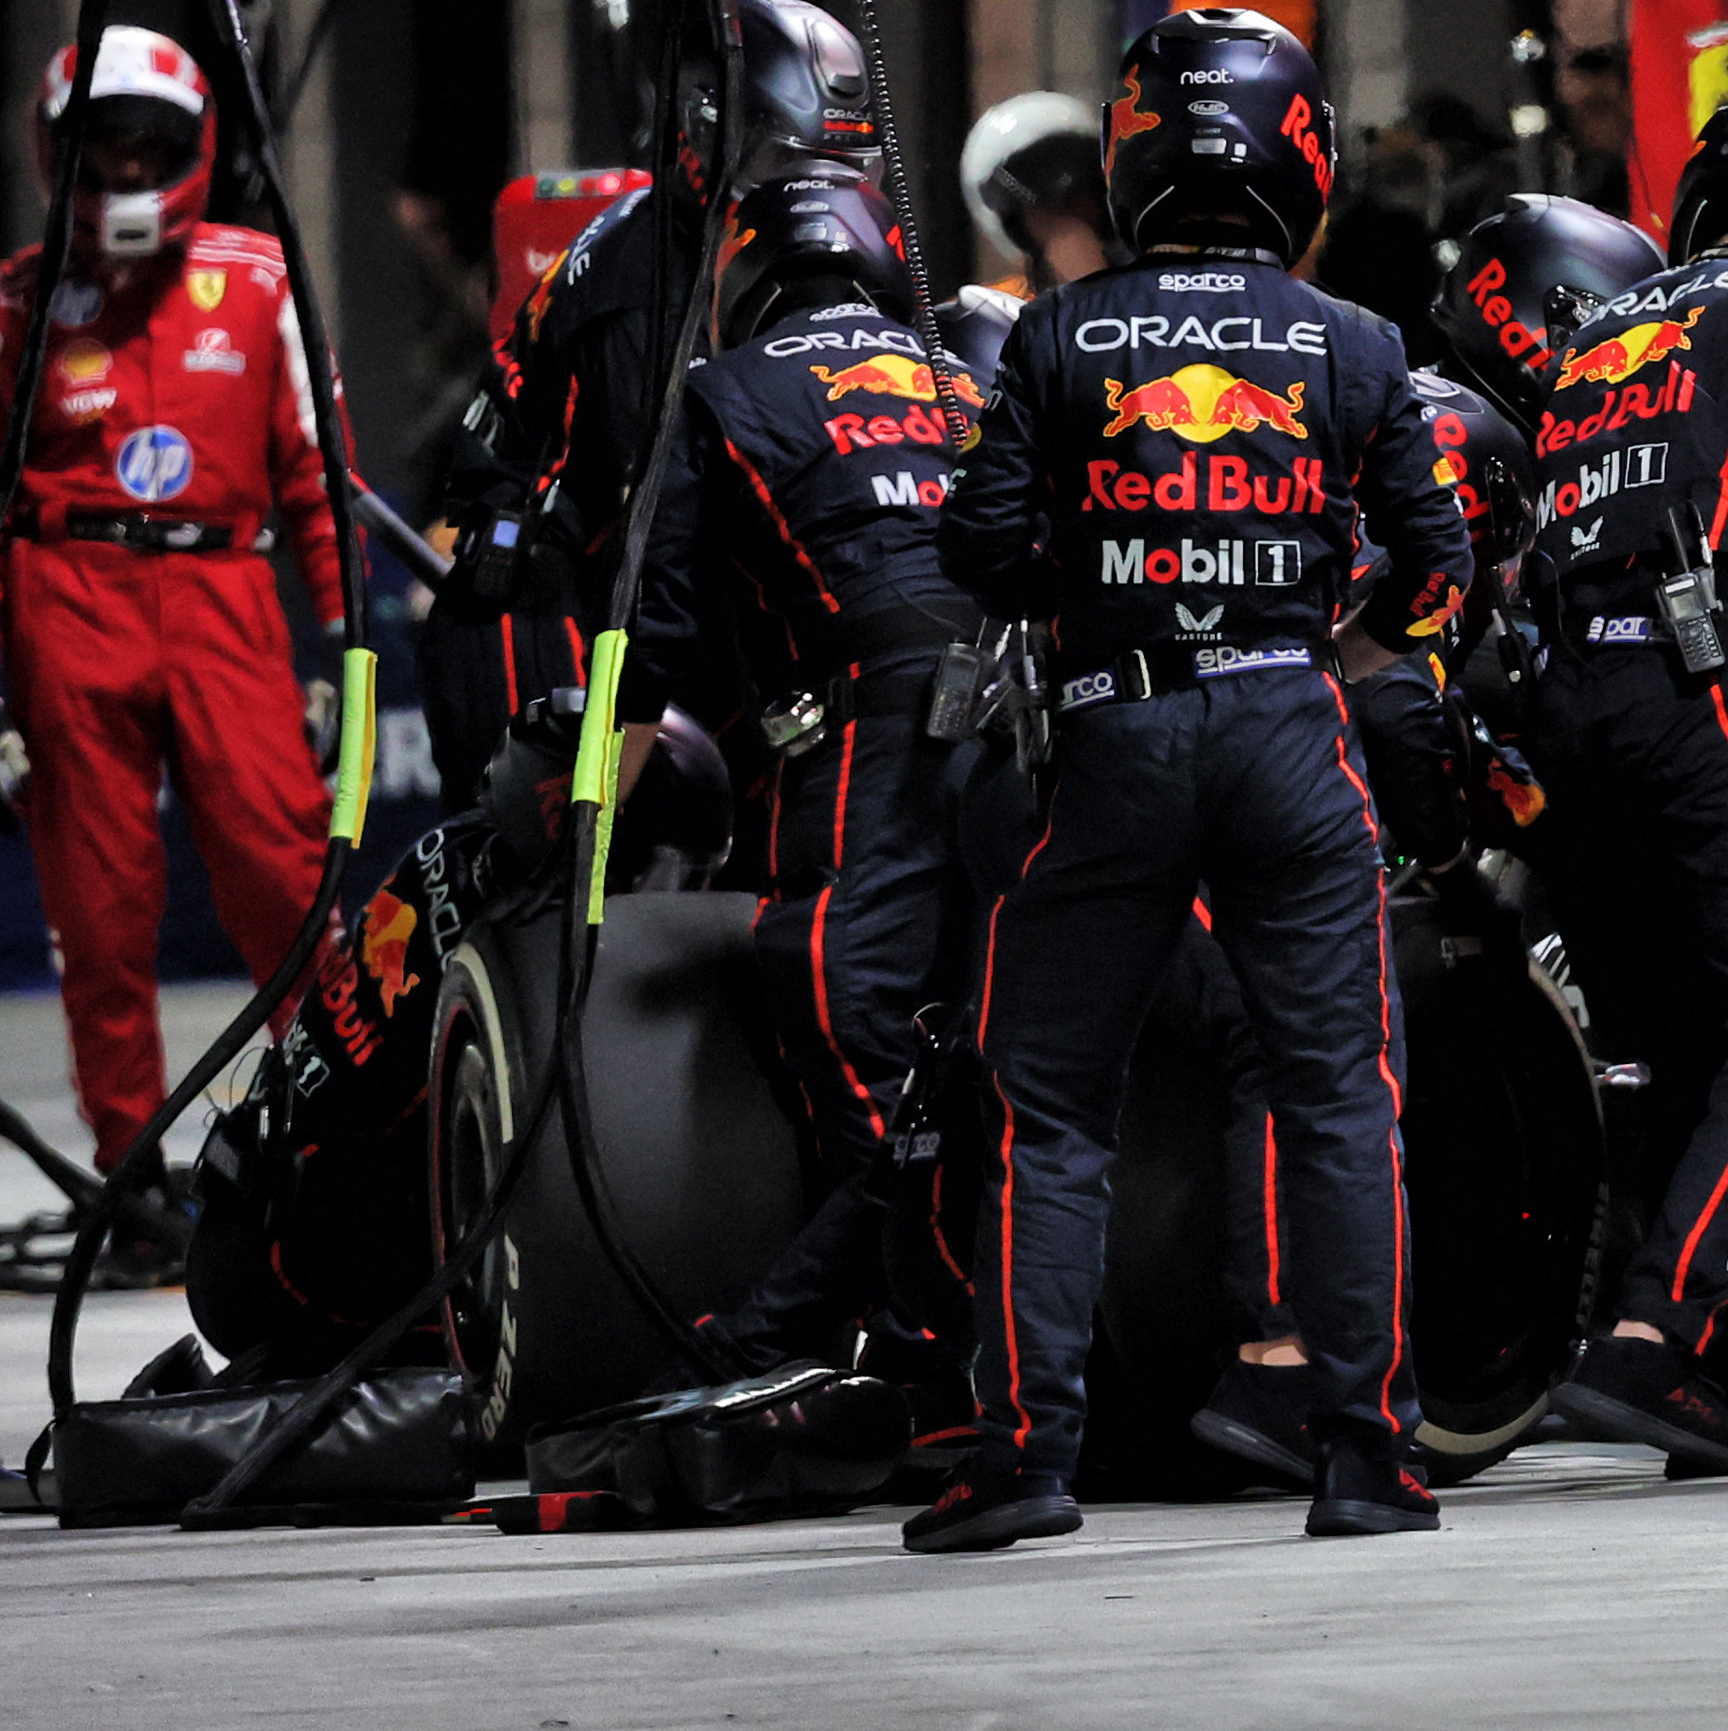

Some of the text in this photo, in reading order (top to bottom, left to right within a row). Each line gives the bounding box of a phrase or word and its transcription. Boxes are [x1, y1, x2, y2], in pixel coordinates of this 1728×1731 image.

[1181, 69, 1234, 85] neat.
[1159, 273, 1246, 293] sparco
[1076, 316, 1327, 356] ORACLE
[1082, 451, 1326, 514] Red Bull
[1535, 450, 1621, 530] Mobil
[1101, 539, 1244, 584] Mobil
[1587, 616, 1647, 642] spar
